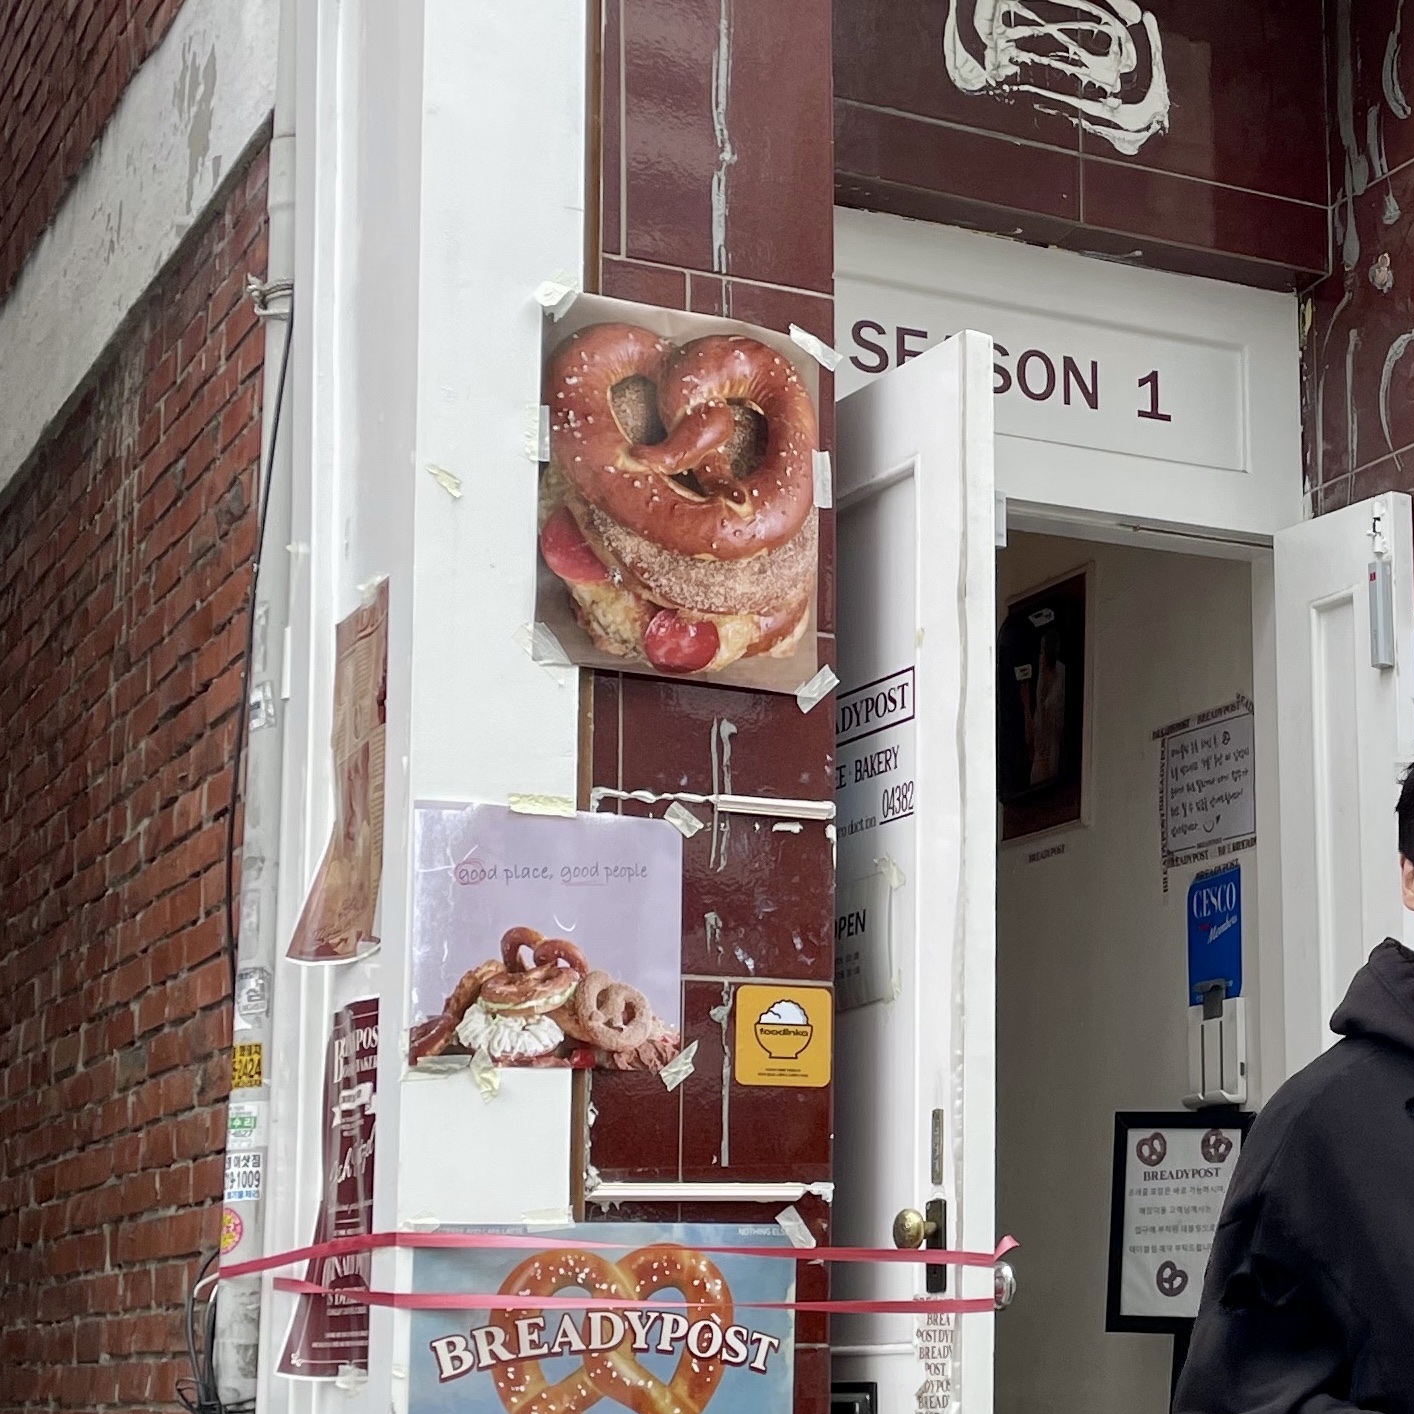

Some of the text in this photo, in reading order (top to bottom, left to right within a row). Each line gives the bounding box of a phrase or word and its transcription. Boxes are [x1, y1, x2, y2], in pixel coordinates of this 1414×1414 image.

[848, 319, 1172, 422] SESON 1
[854, 744, 900, 784] BAKERY
[882, 780, 914, 819] 04382
[458, 863, 648, 885] good place, good people
[1192, 881, 1236, 919] CESCO
[835, 909, 866, 940] PEN
[1142, 1166, 1221, 1182] BREADYPOST
[430, 1308, 781, 1384] BREADYPOST
